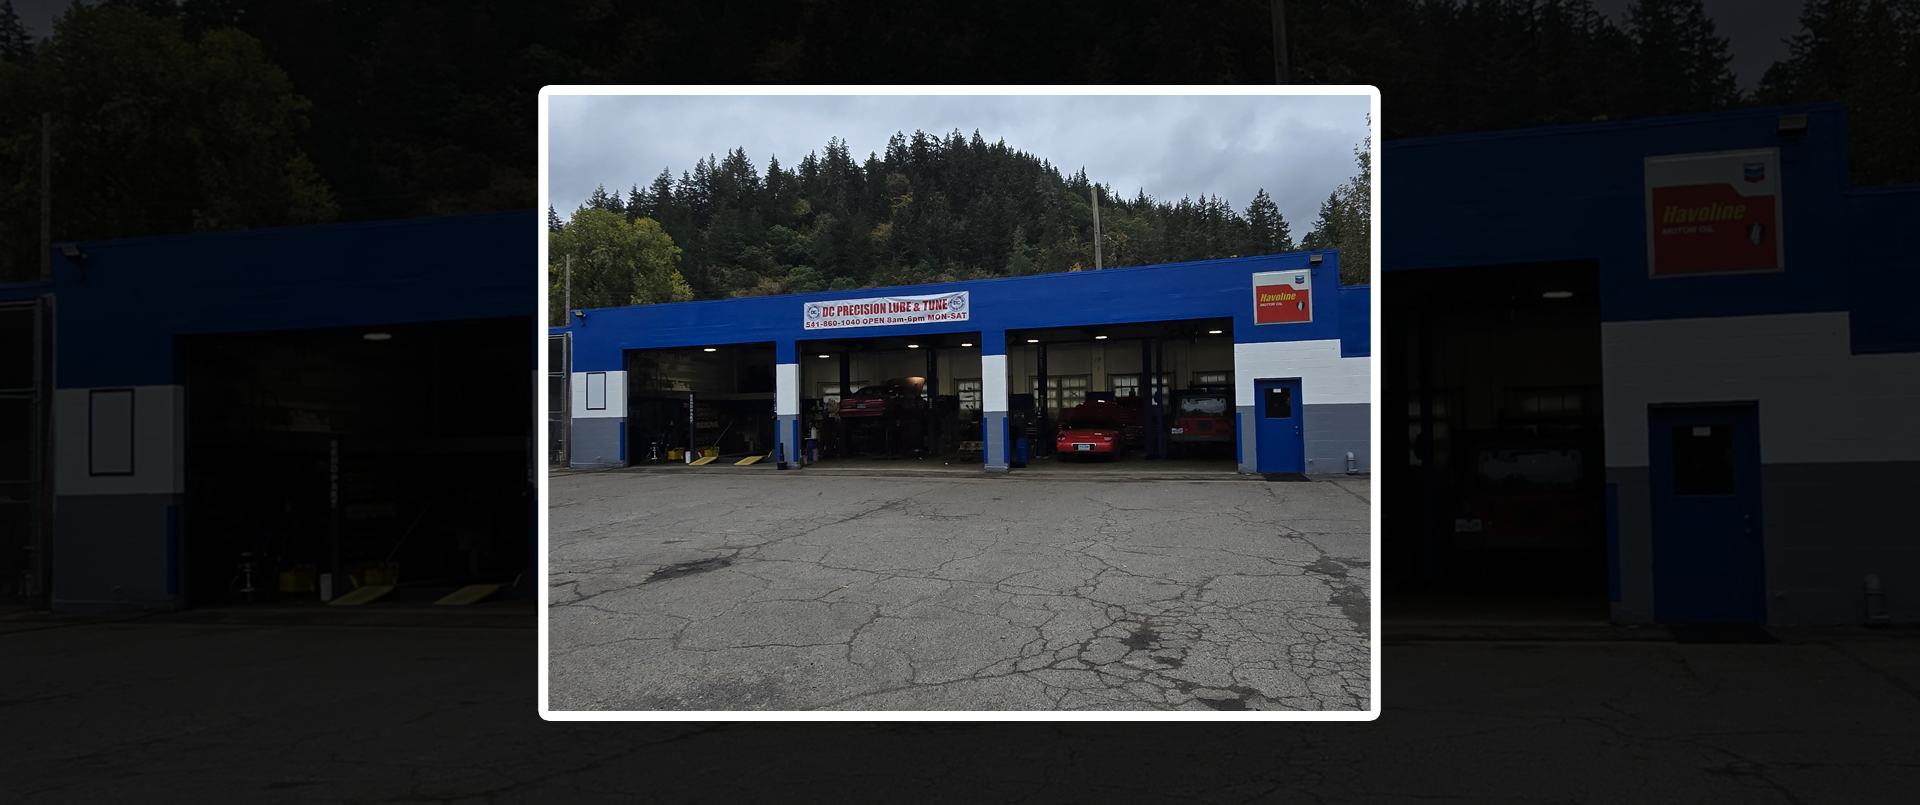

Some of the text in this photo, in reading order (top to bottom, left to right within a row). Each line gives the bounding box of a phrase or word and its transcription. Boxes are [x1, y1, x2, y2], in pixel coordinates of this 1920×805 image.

[1661, 202, 1747, 224] Havoline
[1661, 225, 1714, 236] MOTOR OIL
[1260, 292, 1297, 302] Havoline
[822, 306, 835, 318] DC
[837, 303, 887, 317] PRECISION
[888, 302, 912, 313] LUBE
[913, 302, 921, 312] &
[922, 298, 948, 311] TUNE
[805, 311, 967, 328] 541-860-1040 OPEN 8am-6pm MON-SAT
